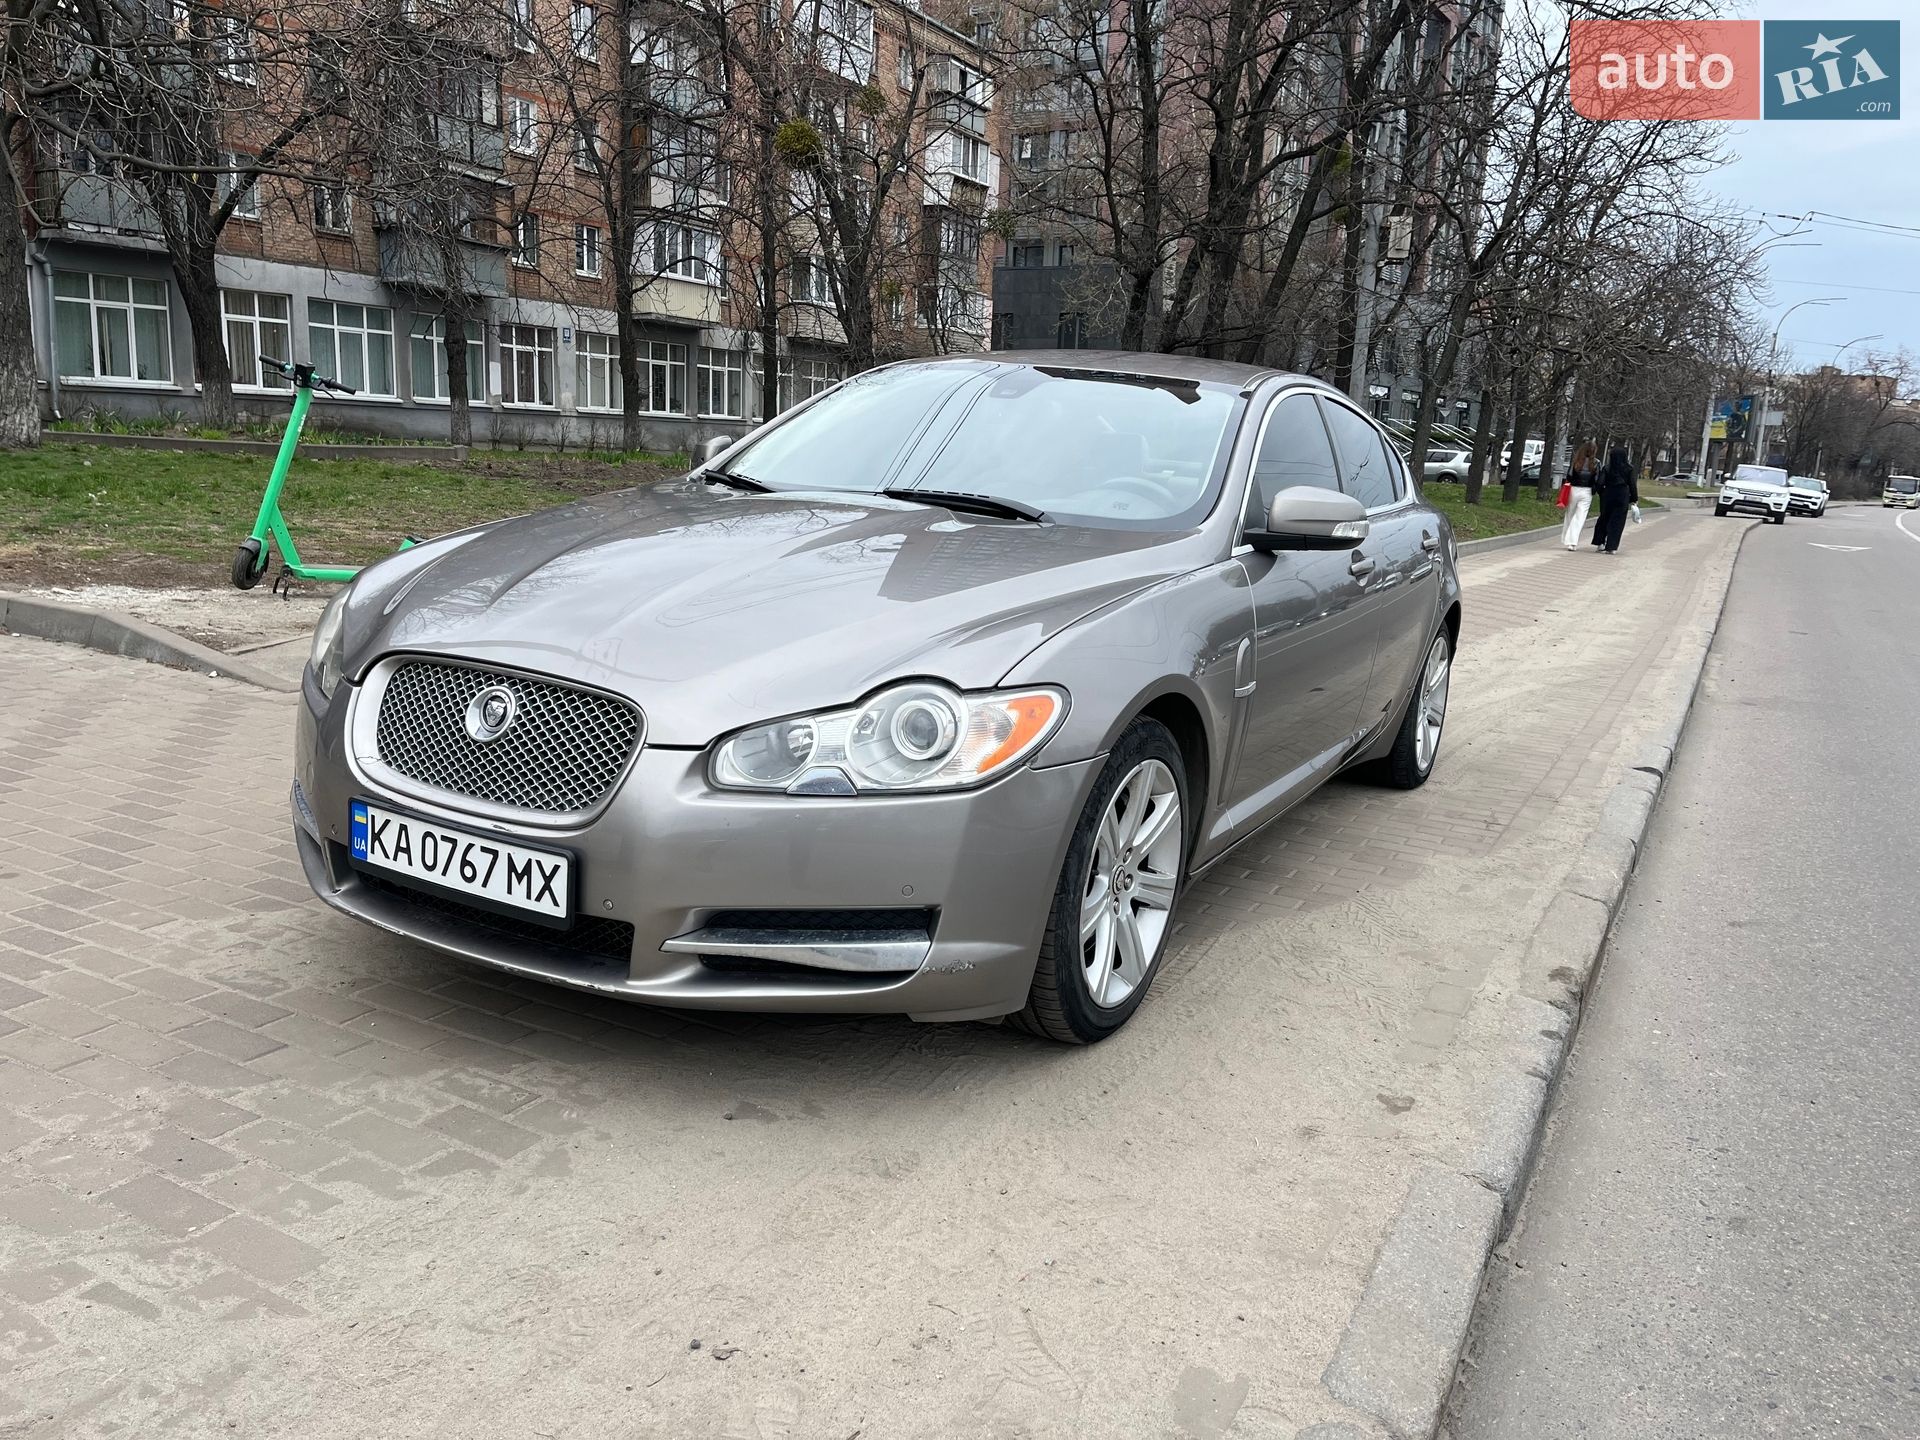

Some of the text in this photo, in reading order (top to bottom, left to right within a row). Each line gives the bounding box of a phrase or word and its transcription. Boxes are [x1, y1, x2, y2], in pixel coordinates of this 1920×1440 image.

[354, 836, 366, 852] UA
[370, 814, 561, 908] KA 0767 MX
